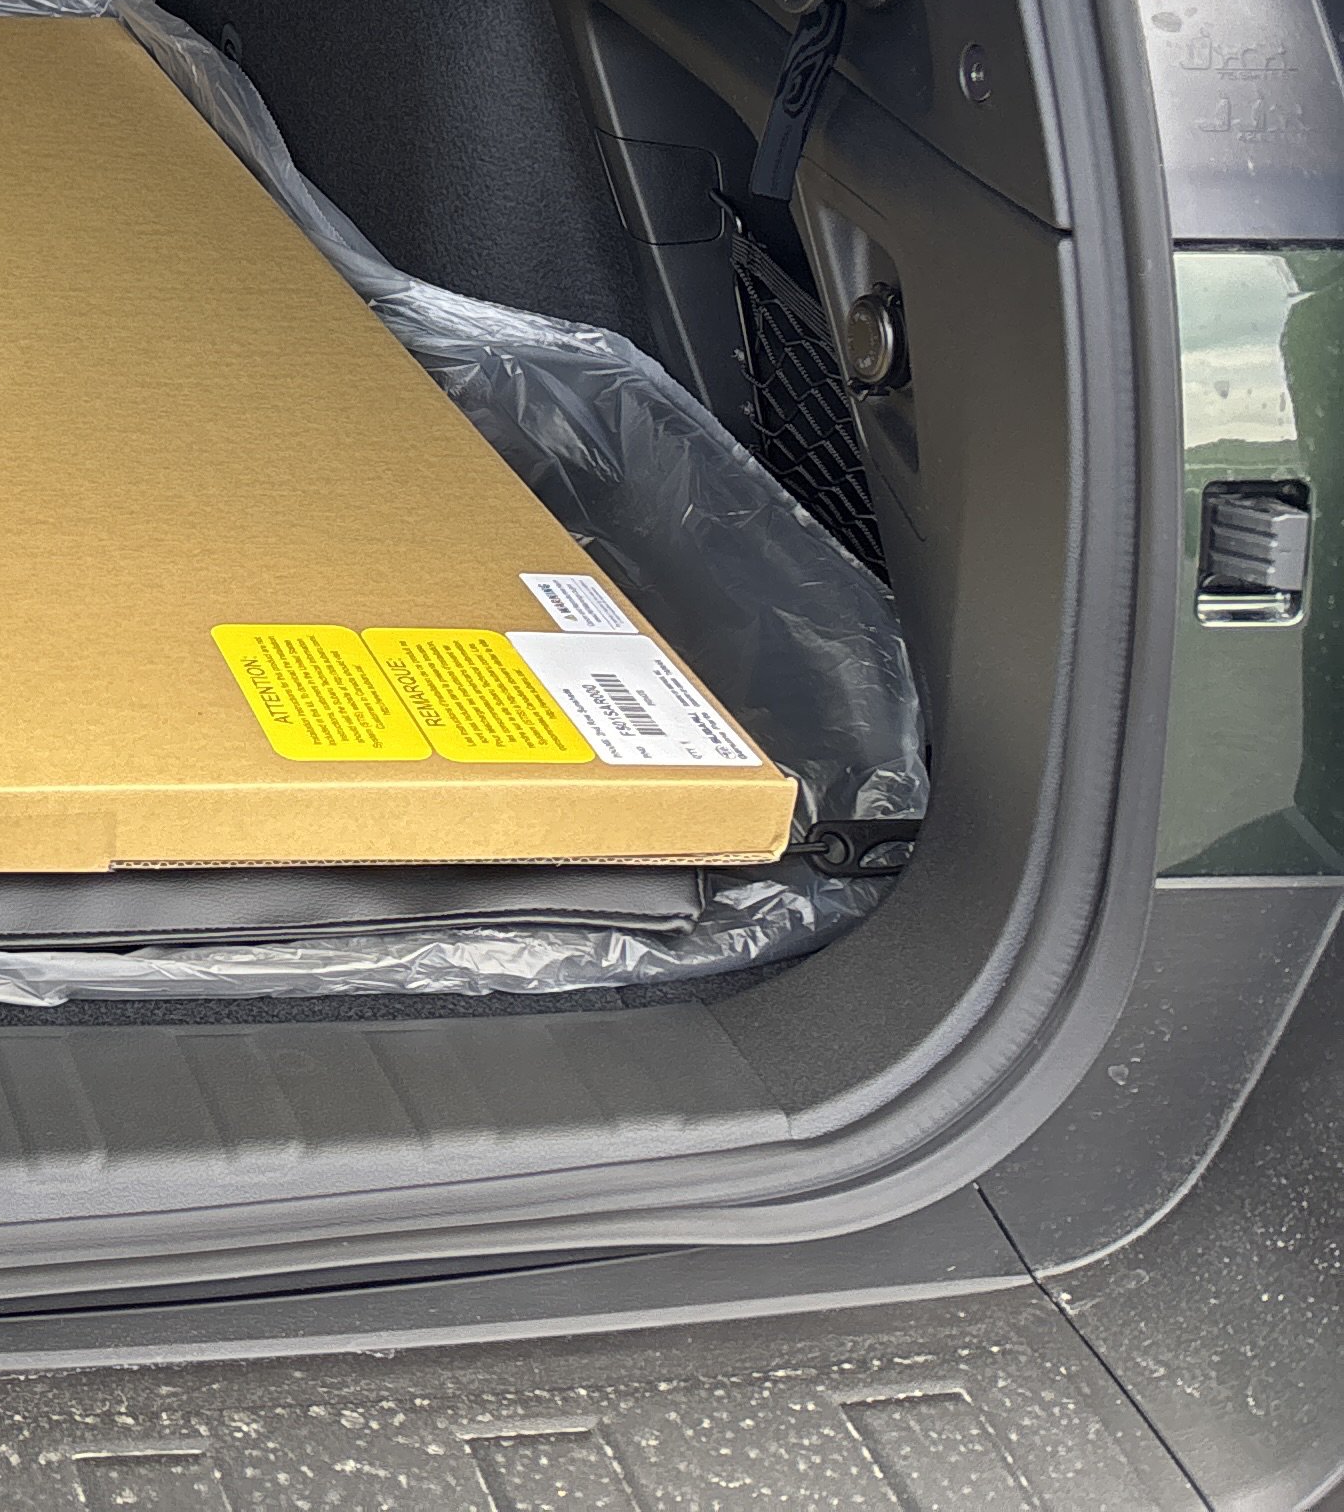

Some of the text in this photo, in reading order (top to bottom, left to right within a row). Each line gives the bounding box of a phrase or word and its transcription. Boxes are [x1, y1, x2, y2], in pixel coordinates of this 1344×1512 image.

[241, 659, 292, 724] ATTENTION:
[386, 657, 444, 726] REMARQUE:
[688, 712, 721, 743] SUBARU
[701, 711, 720, 729] Parts
